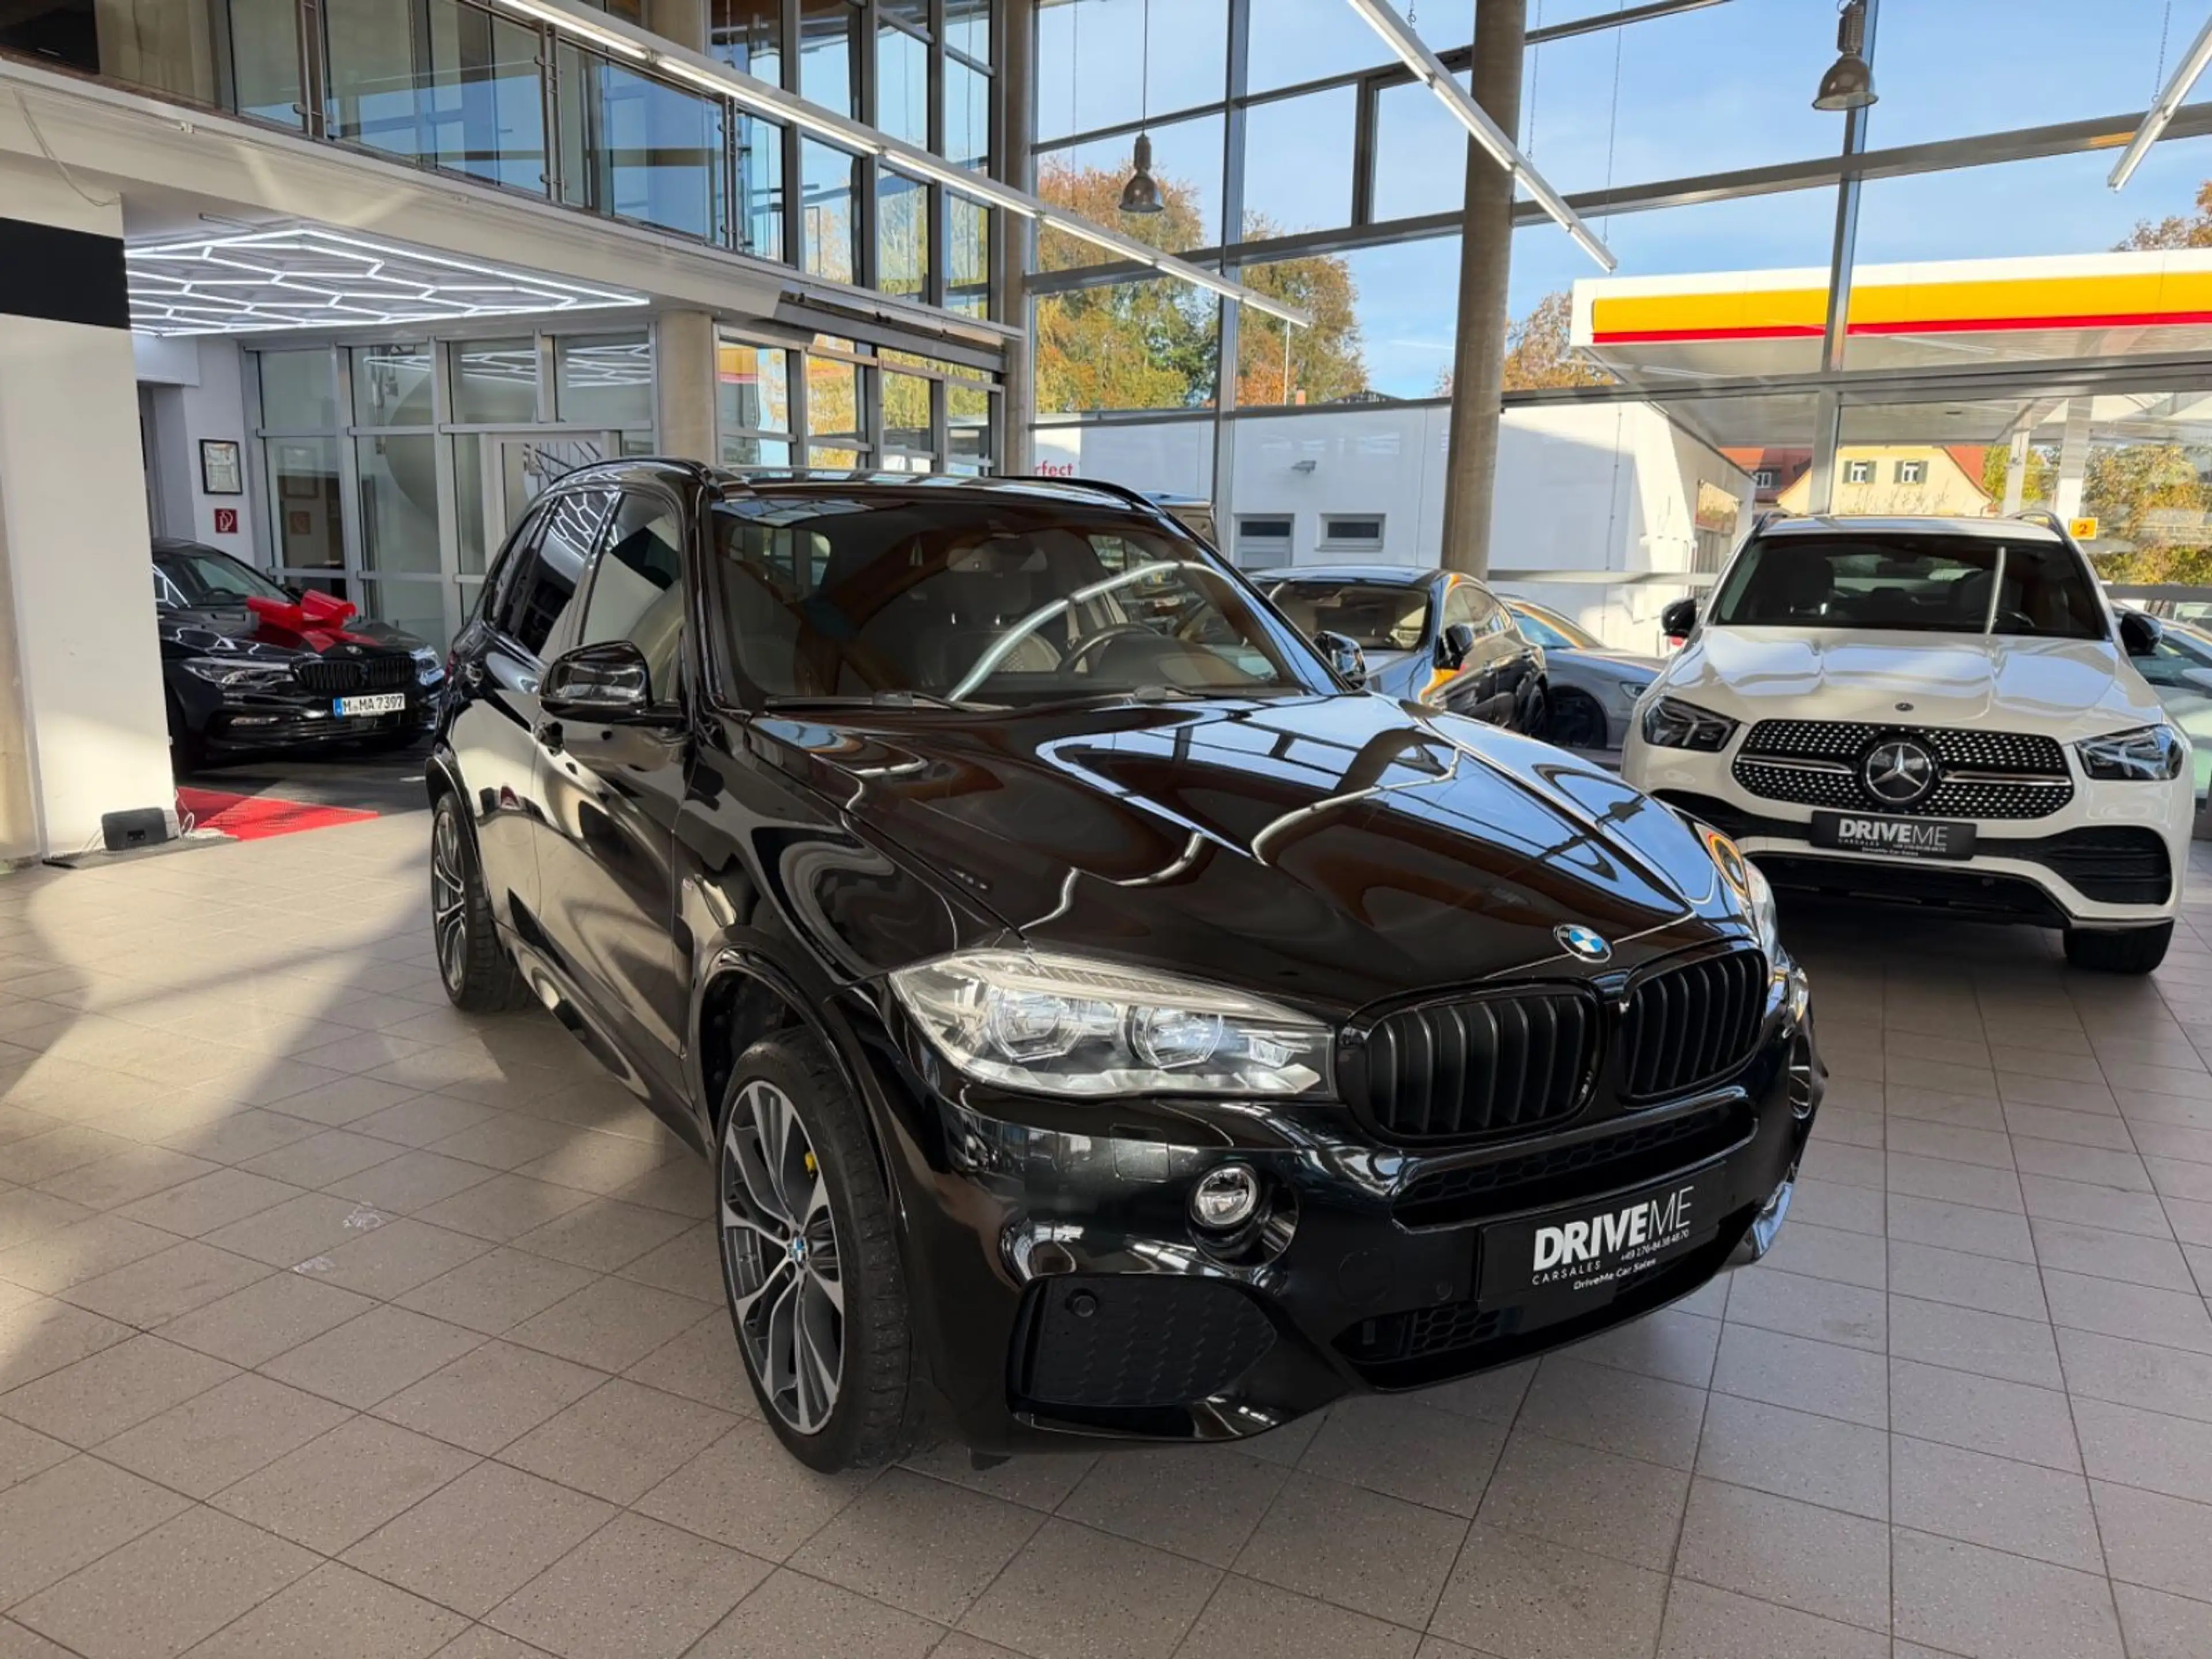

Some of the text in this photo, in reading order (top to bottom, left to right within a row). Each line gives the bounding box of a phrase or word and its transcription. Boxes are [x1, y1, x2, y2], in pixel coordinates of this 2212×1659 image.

[2078, 522, 2088, 535] 2
[376, 695, 403, 710] 7397
[1838, 818, 1949, 847] DRIVEME
[1533, 1185, 1694, 1272] DRIVEME
[1532, 1260, 1601, 1285] CARSALES
[1573, 1272, 1613, 1290] DriveMe
[1615, 1267, 1633, 1277] Car
